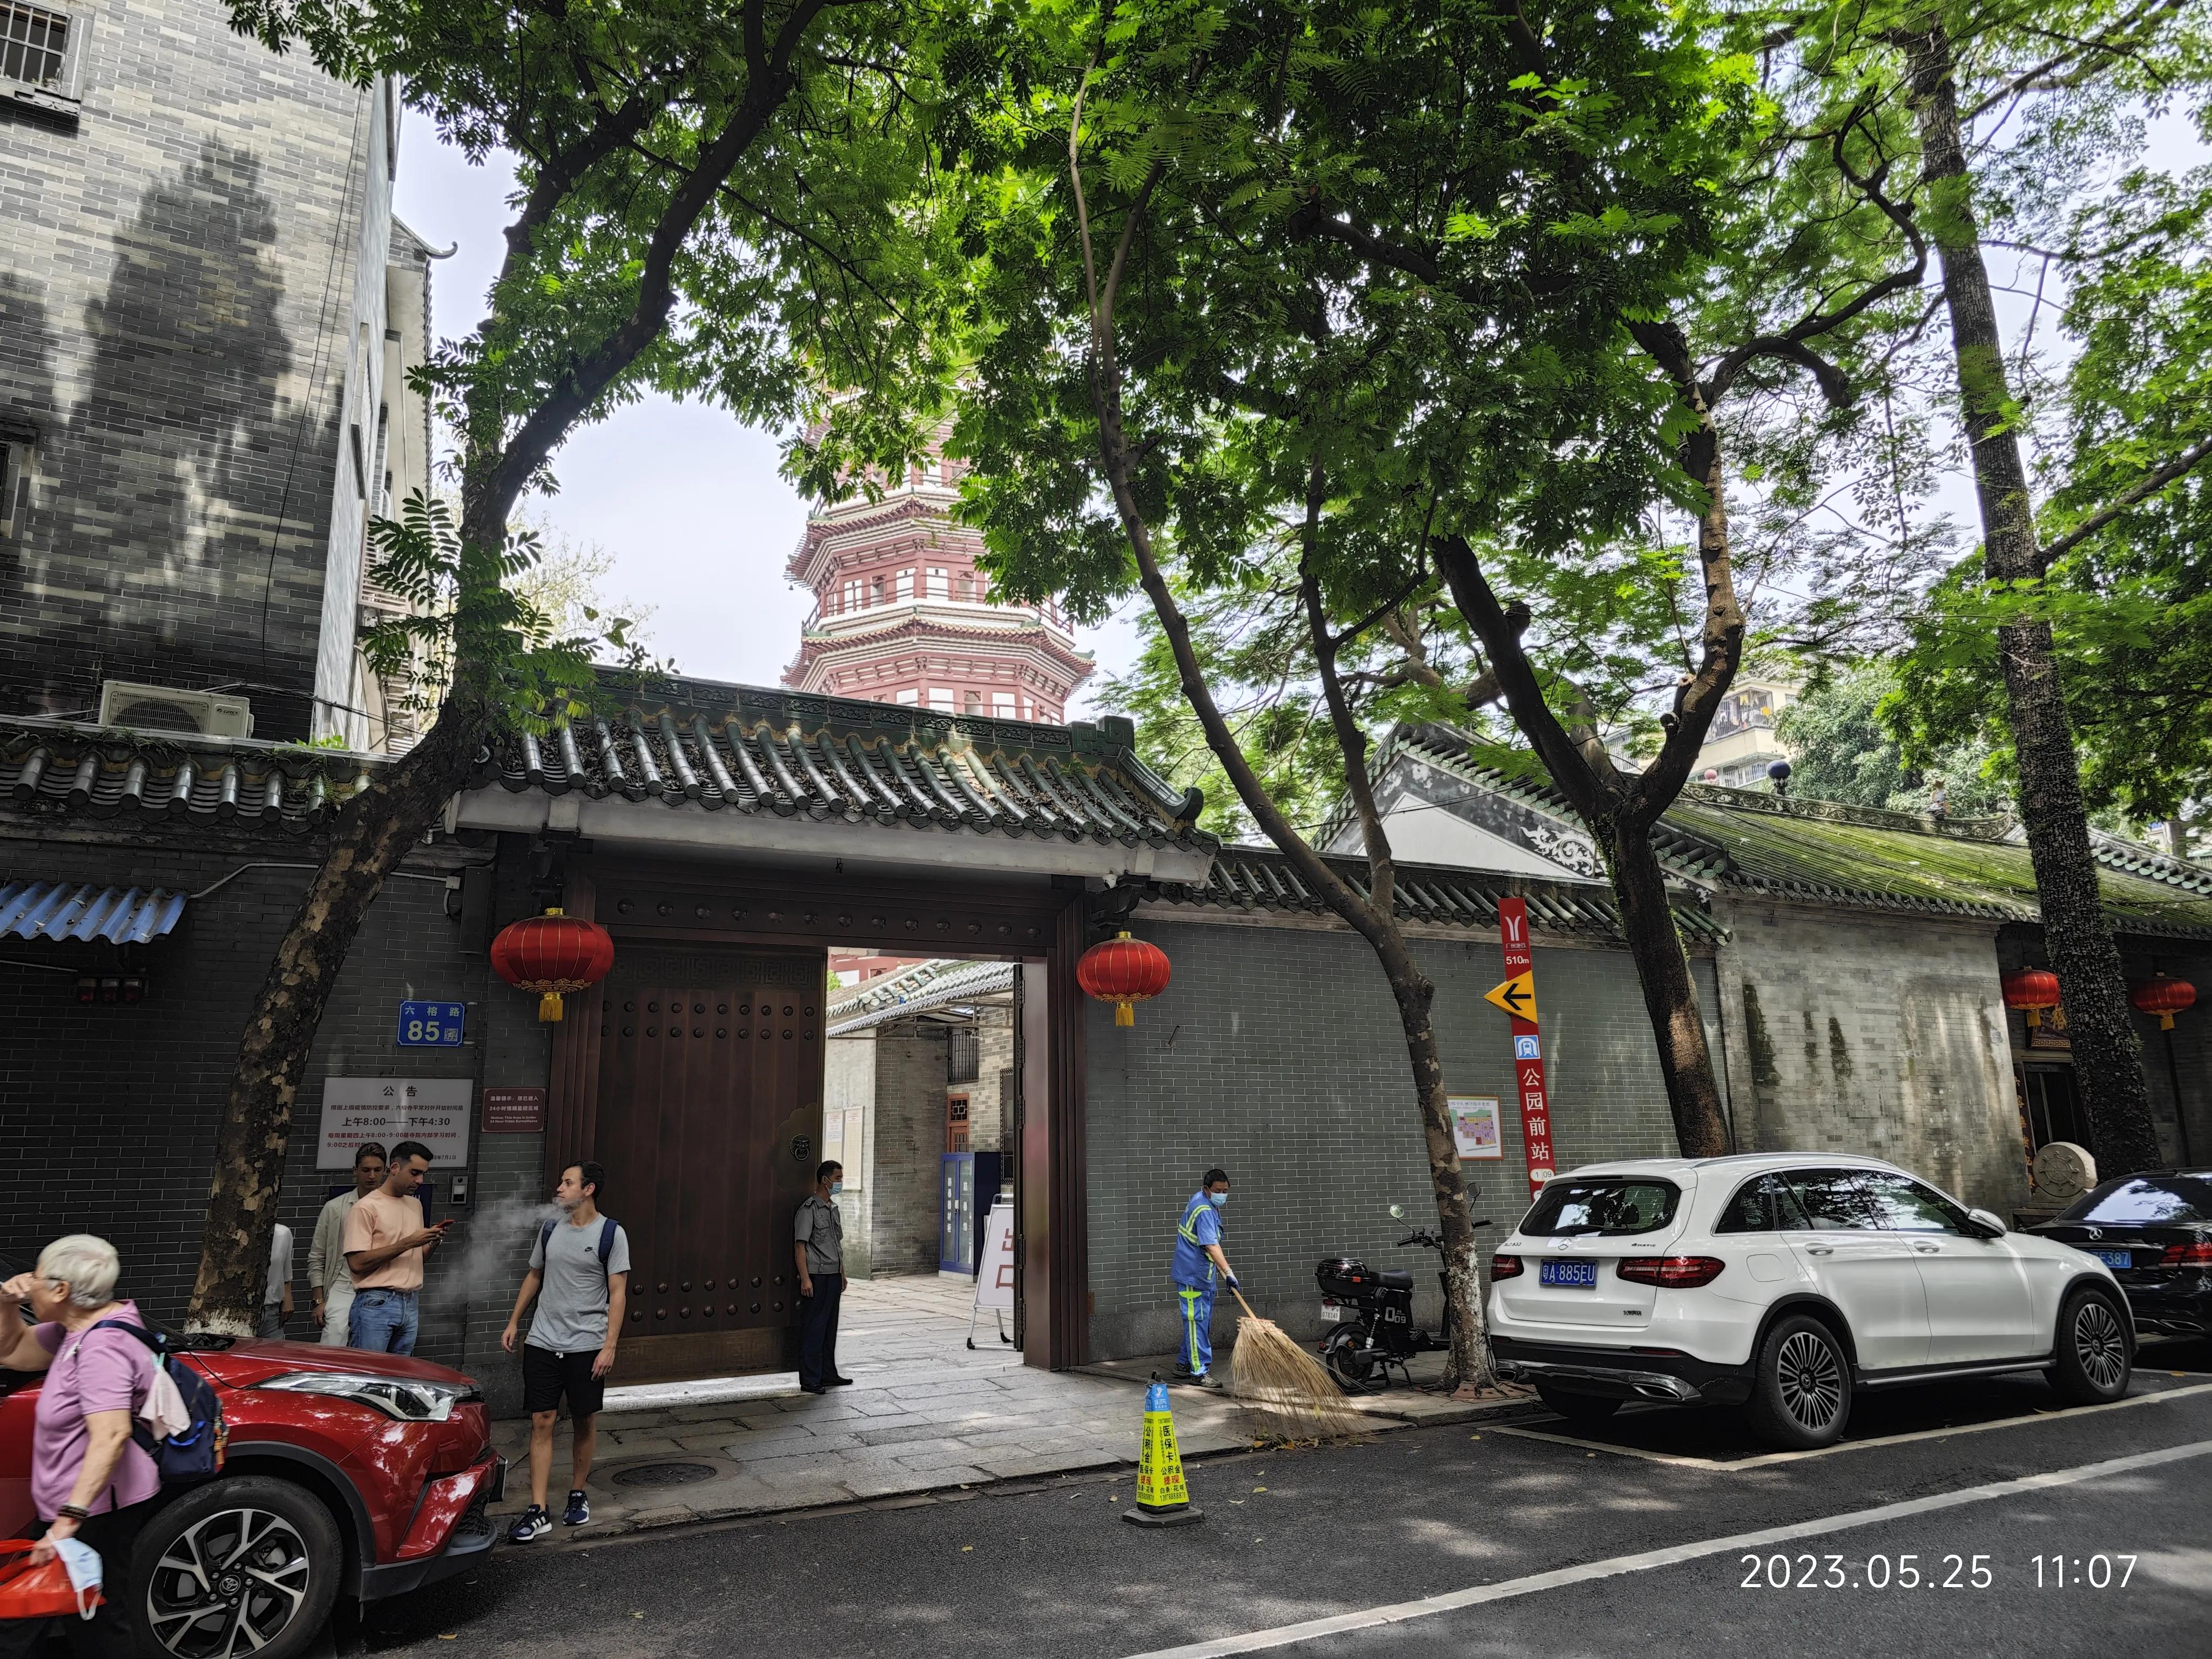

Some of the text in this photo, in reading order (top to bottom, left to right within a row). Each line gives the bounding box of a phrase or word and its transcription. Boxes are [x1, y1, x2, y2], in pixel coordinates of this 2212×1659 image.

[1506, 955, 1529, 965] 510m
[404, 1006, 460, 1017] 六榕路
[407, 1020, 440, 1041] 85
[382, 1085, 418, 1097] 公告
[1522, 1068, 1550, 1161] 公园前站
[1163, 1425, 1174, 1463] 医保卡
[1139, 1464, 1154, 1475] 医保卡
[1161, 1464, 1181, 1475] 公积金
[1141, 1474, 1151, 1486] 提现
[1164, 1475, 1180, 1485] 提现
